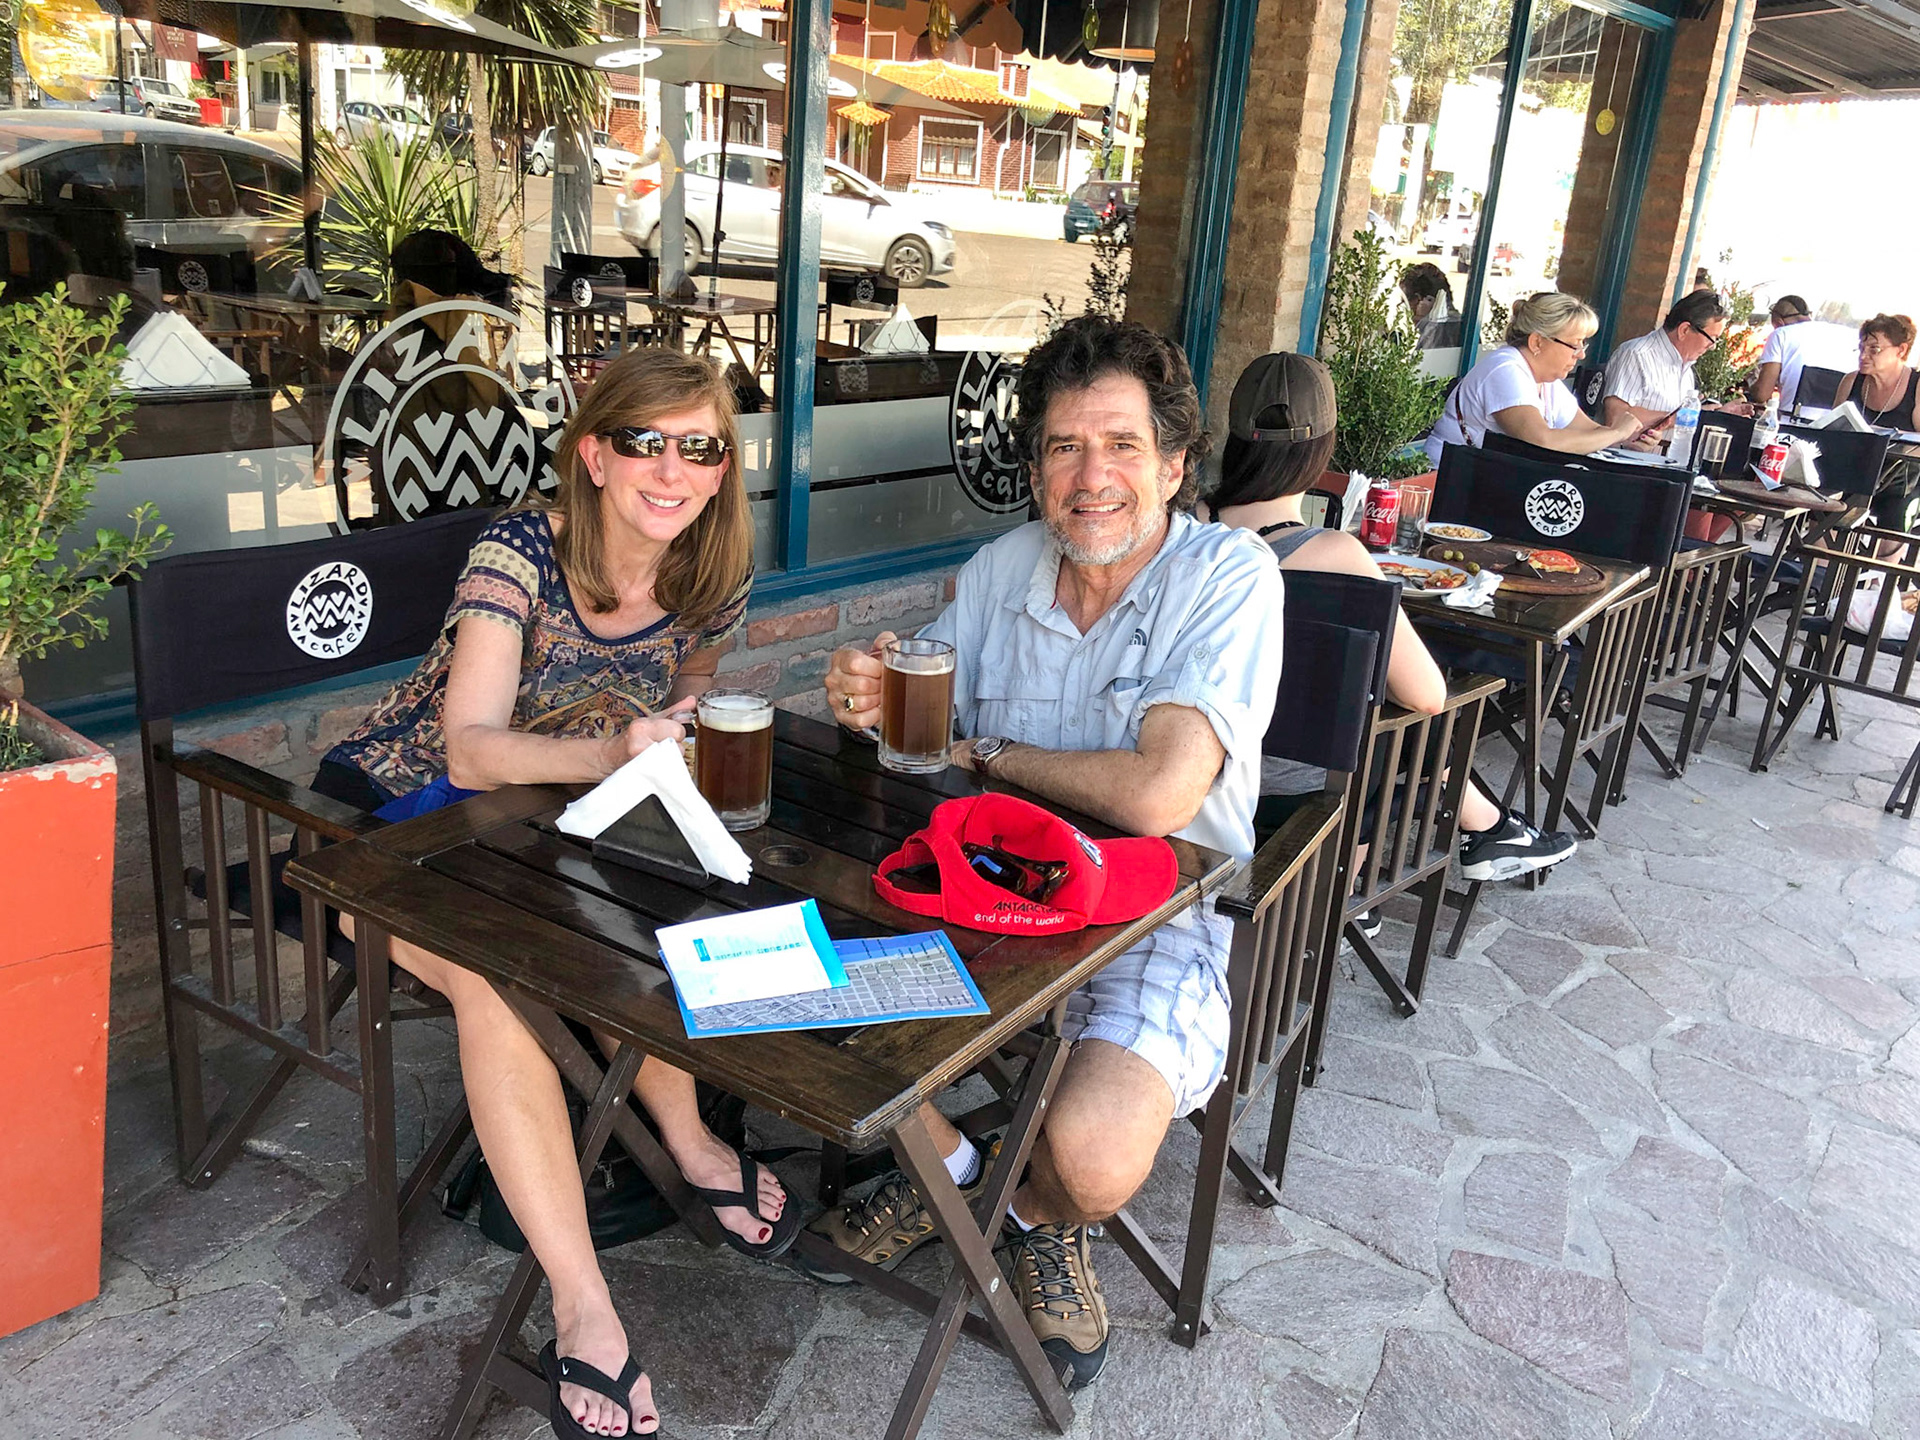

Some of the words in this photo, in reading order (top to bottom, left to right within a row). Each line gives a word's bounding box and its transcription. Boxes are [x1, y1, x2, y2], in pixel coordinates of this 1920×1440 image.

[981, 468, 1027, 501] caf
[1529, 483, 1582, 509] LIZARD
[290, 563, 368, 609] LIZARD
[310, 626, 358, 655] café
[974, 913, 996, 923] end
[999, 913, 1012, 924] of
[1014, 914, 1033, 924] the
[1035, 915, 1065, 926] world
